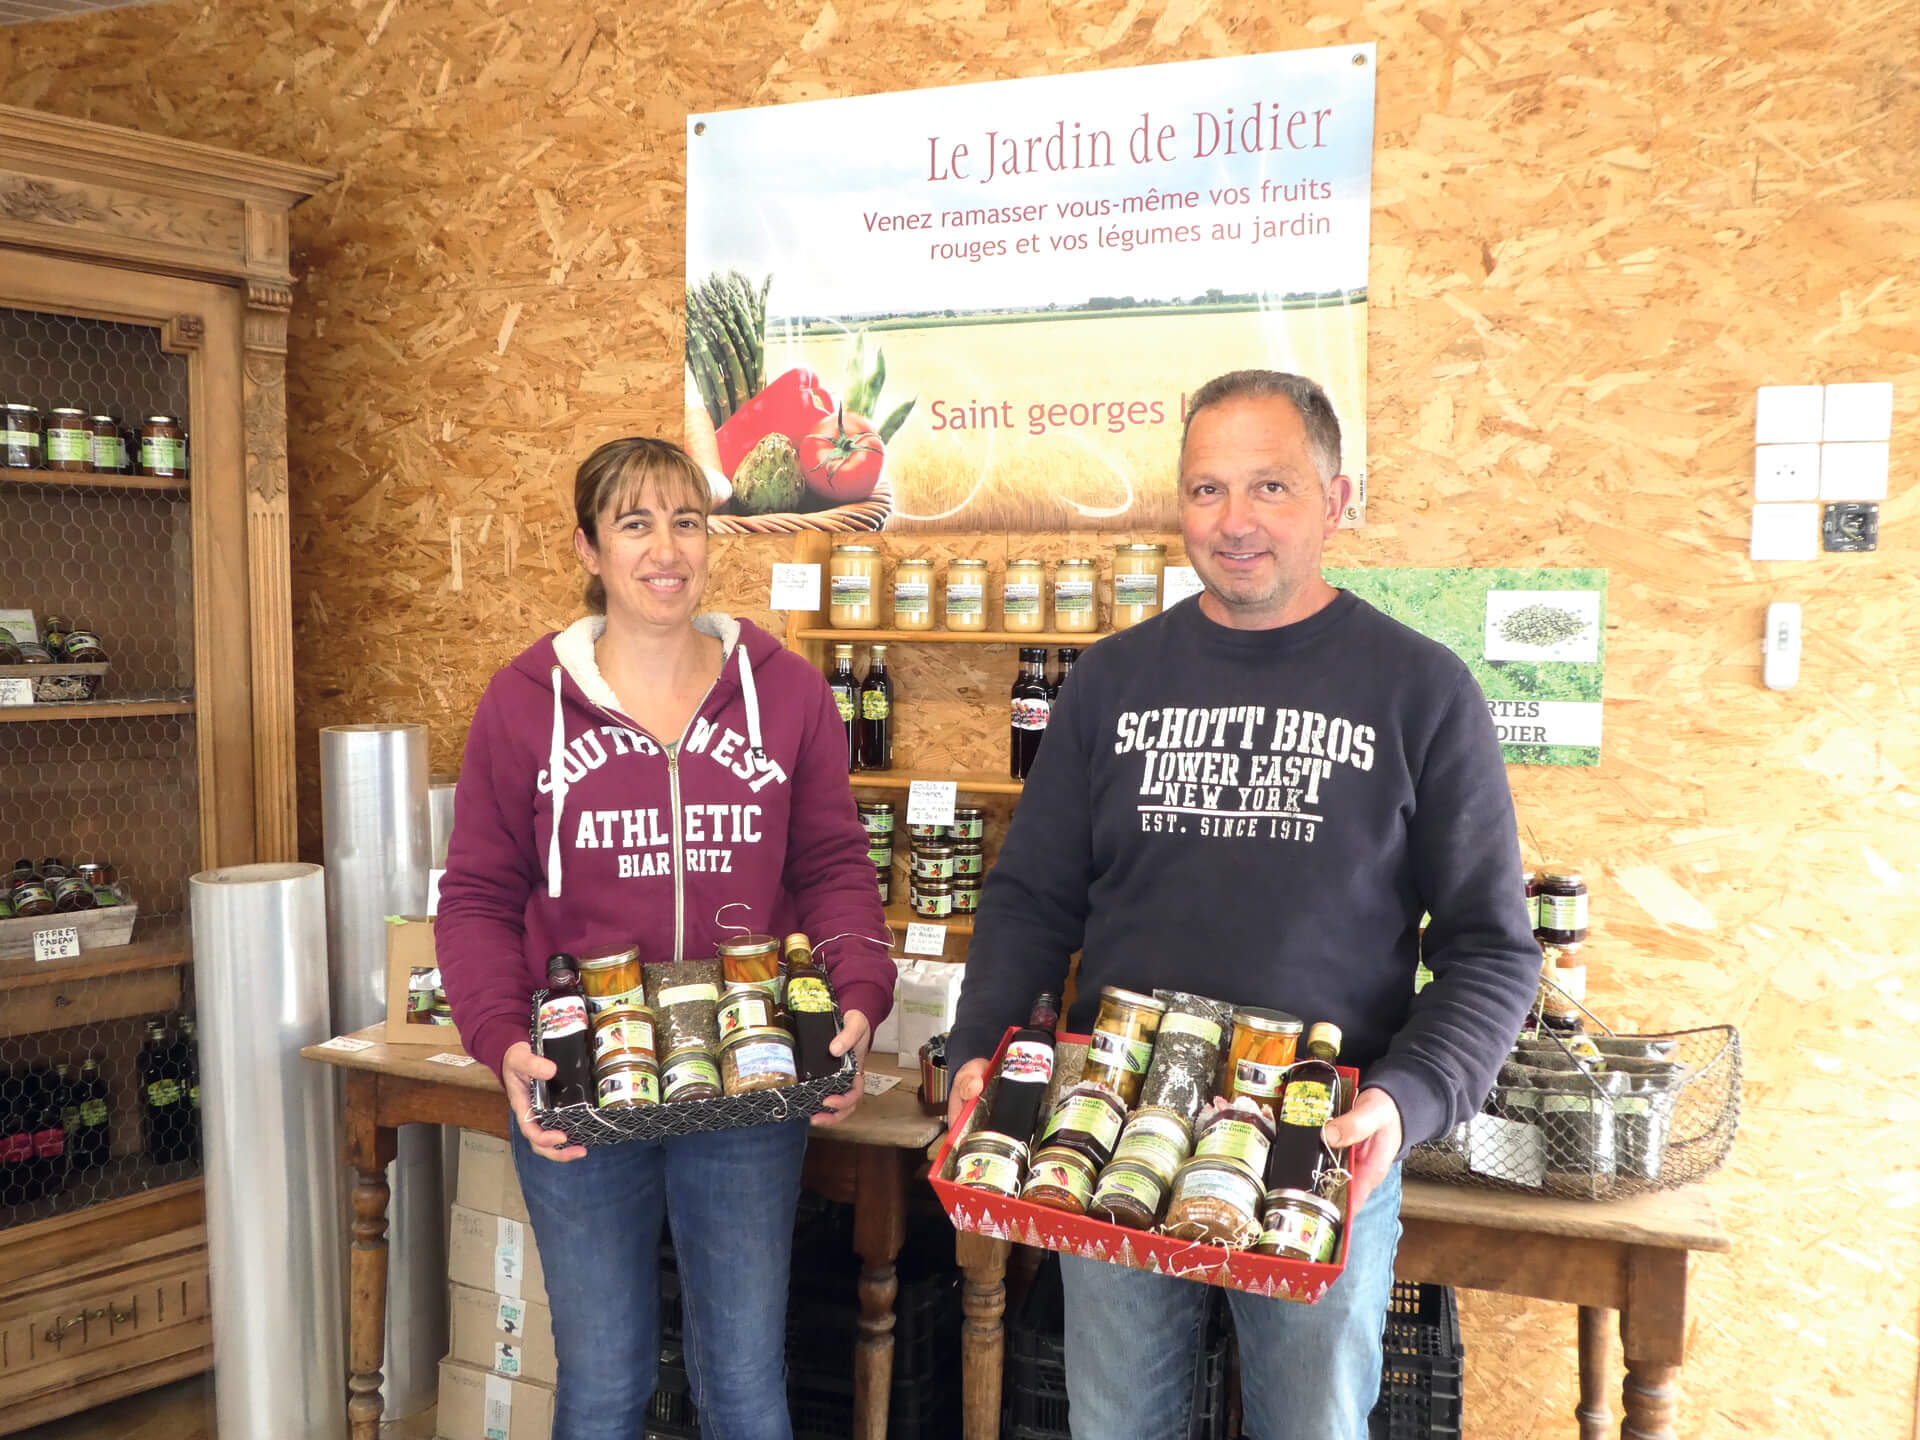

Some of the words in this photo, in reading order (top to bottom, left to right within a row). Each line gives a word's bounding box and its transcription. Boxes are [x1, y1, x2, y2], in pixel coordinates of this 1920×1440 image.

[927, 136, 969, 182] Le
[980, 120, 1116, 184] Jardin
[1129, 112, 1176, 165] de
[1192, 100, 1332, 159] Didier
[863, 211, 934, 233] Venez
[941, 202, 1049, 228] ramasser
[1057, 187, 1199, 220] vous-même
[1208, 183, 1251, 206] vos
[1261, 176, 1332, 202] fruits
[930, 233, 1007, 262] rouges
[1016, 235, 1041, 254] et
[1049, 228, 1089, 251] vos
[1098, 223, 1201, 252] légumes
[1211, 221, 1242, 241] au
[1251, 212, 1330, 245] jardin
[931, 399, 1015, 431] Saint
[1027, 400, 1165, 435] georges
[1487, 701, 1540, 718] RTES
[1115, 706, 1265, 755] SCHOTT
[1270, 708, 1376, 771] BROS
[1494, 725, 1547, 743] DIER
[685, 716, 787, 794] WEST
[1139, 750, 1239, 795] LOWER
[1248, 755, 1332, 804] EAST
[1163, 783, 1223, 810] NEW
[1238, 787, 1303, 812] YORK
[1142, 813, 1187, 834] EST.
[1200, 817, 1258, 838] SINCE
[1269, 820, 1316, 843] 1913
[34, 928, 76, 939] COFFRET
[40, 937, 74, 946] CADEAU
